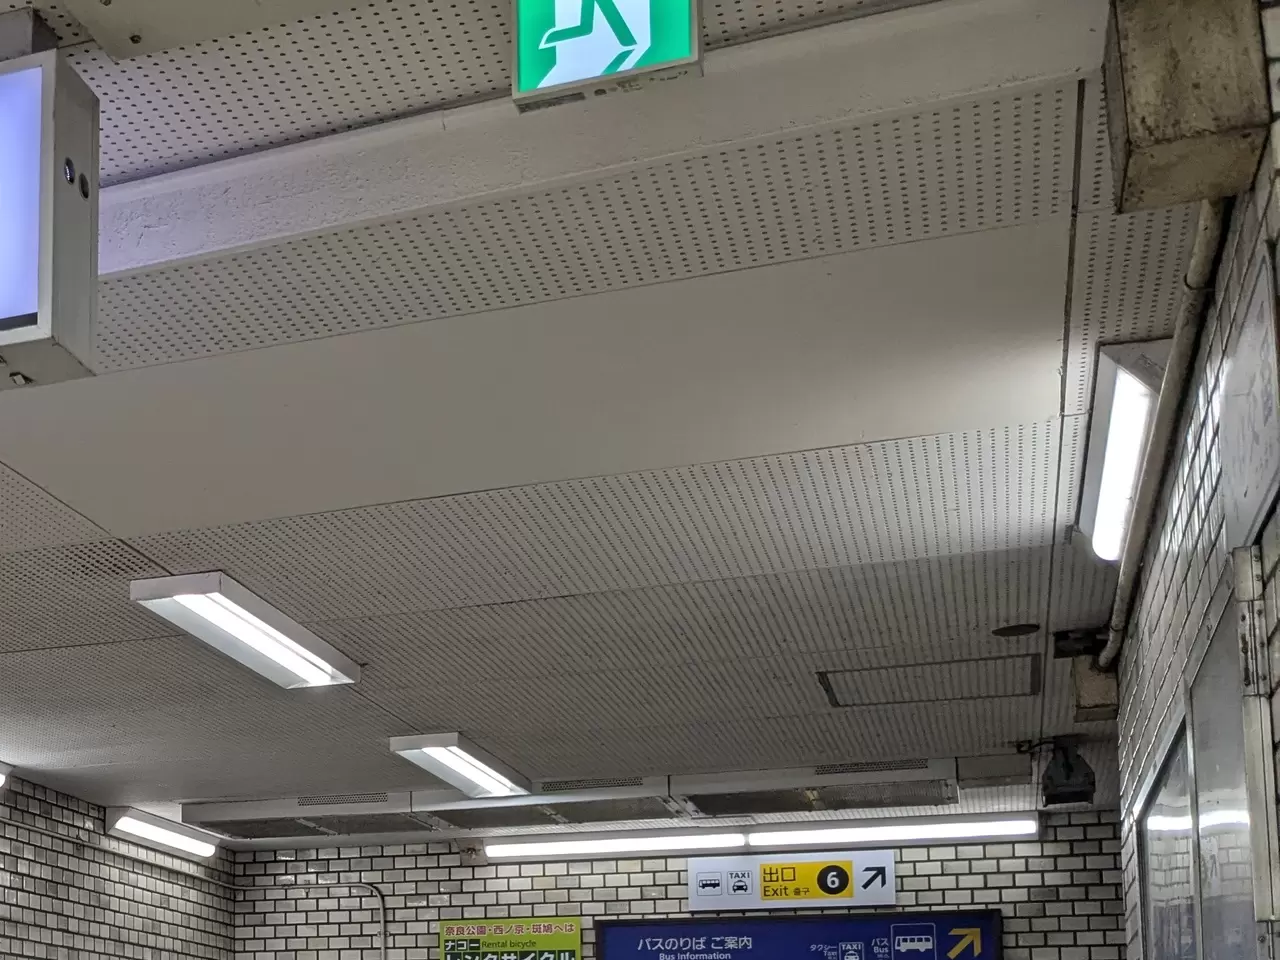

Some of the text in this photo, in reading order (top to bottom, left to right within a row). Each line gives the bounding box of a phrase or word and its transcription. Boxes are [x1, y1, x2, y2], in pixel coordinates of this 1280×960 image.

[729, 872, 750, 880] TAXI
[763, 867, 839, 888] 出口 6
[763, 885, 789, 897] Exit
[509, 940, 536, 949] bicycle
[638, 936, 752, 950] バスのりば ご案内
[871, 938, 889, 946] バス
[678, 952, 731, 960] Information
